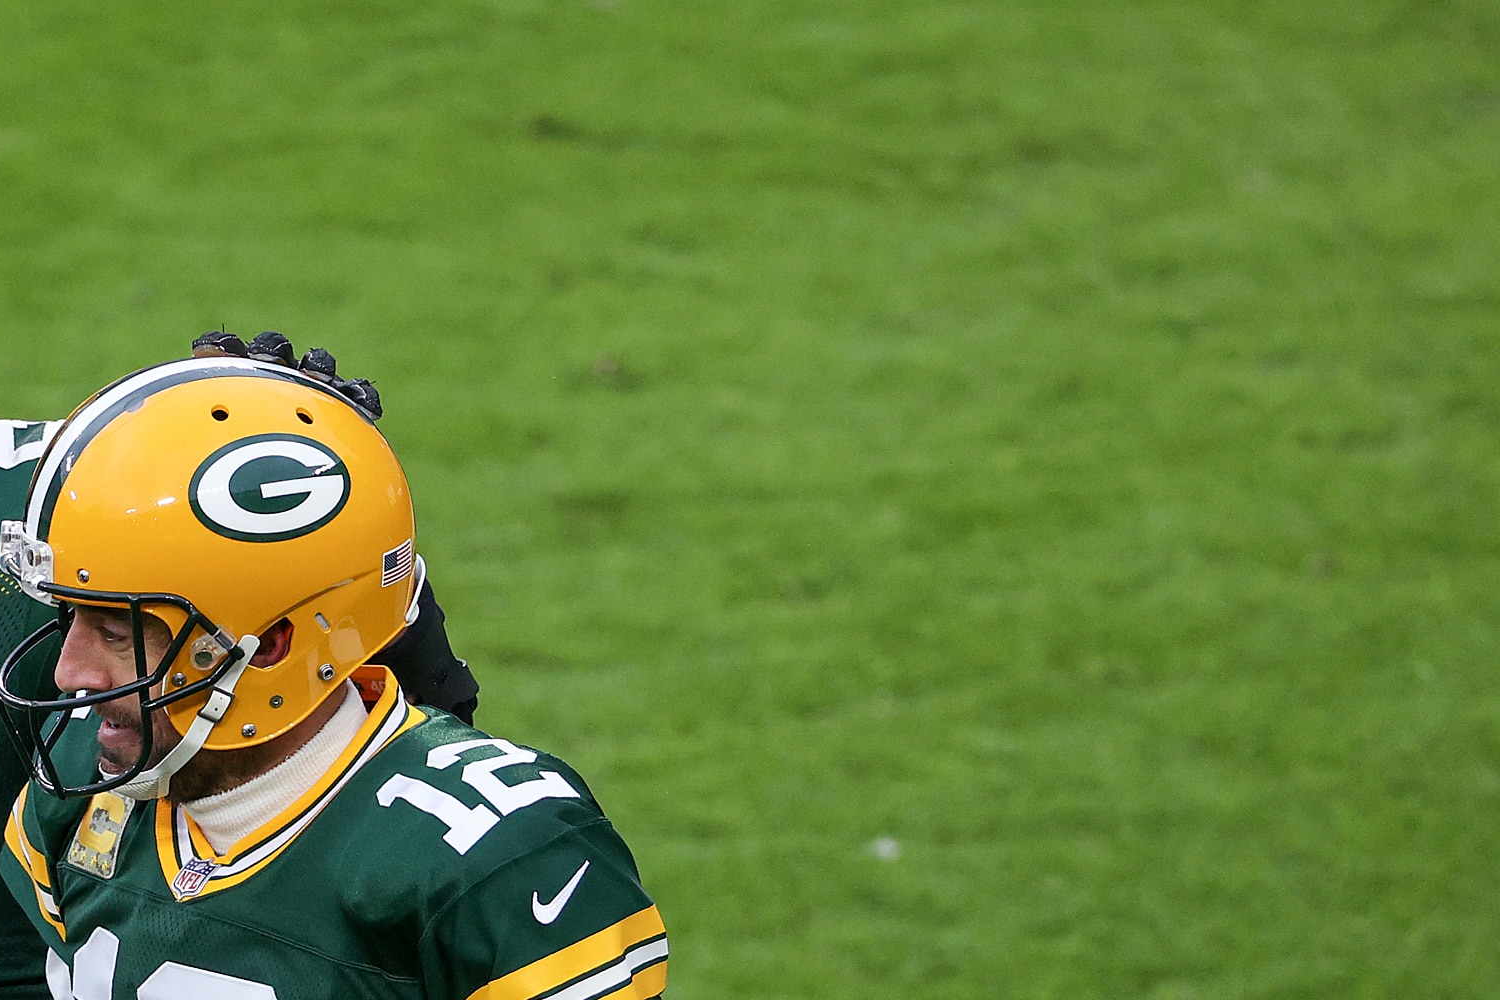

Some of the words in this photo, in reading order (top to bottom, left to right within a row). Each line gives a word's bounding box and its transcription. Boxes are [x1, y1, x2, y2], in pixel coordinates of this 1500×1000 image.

[197, 440, 345, 535] G
[79, 790, 125, 854] C
[376, 738, 582, 857] 12
[176, 870, 202, 890] NFL
